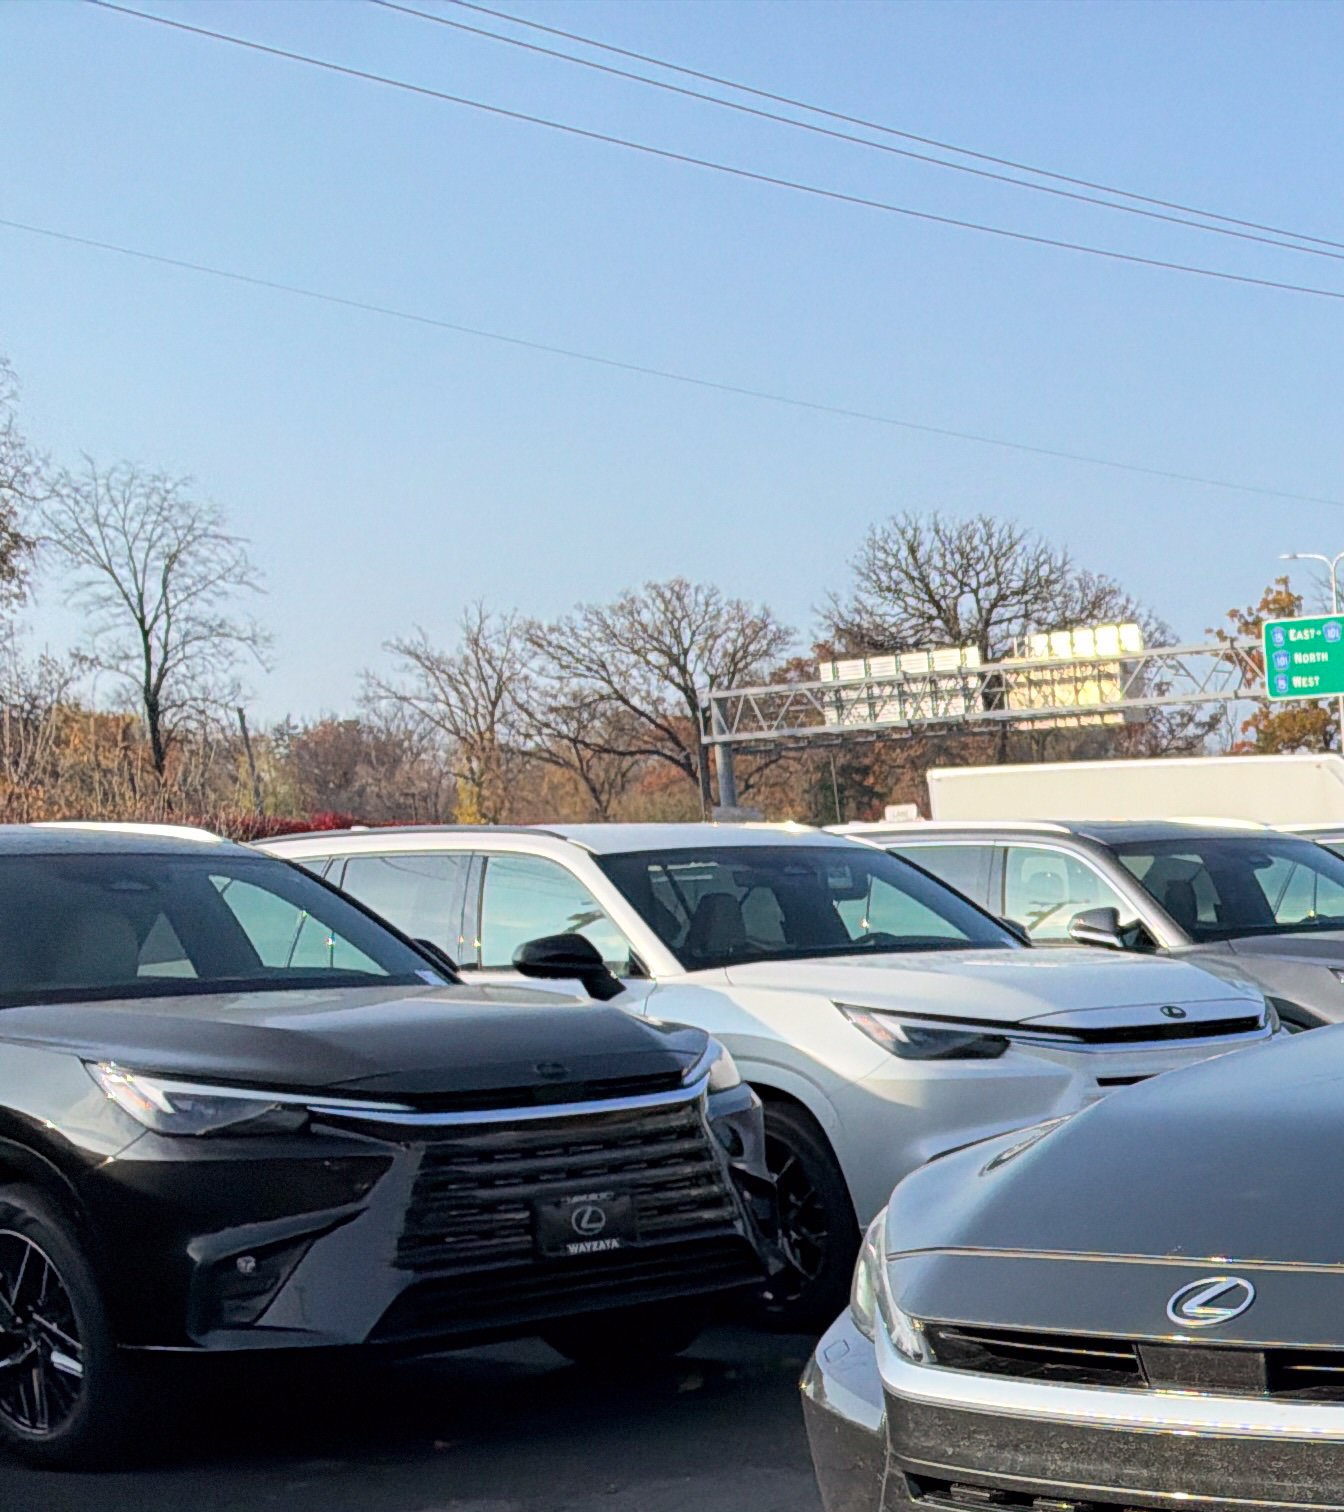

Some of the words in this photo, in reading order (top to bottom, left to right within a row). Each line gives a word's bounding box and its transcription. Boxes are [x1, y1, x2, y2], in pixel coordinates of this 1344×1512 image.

[1294, 652, 1329, 665] NORTH
[1293, 676, 1320, 688] WEST
[566, 1238, 620, 1256] WAYZATA
